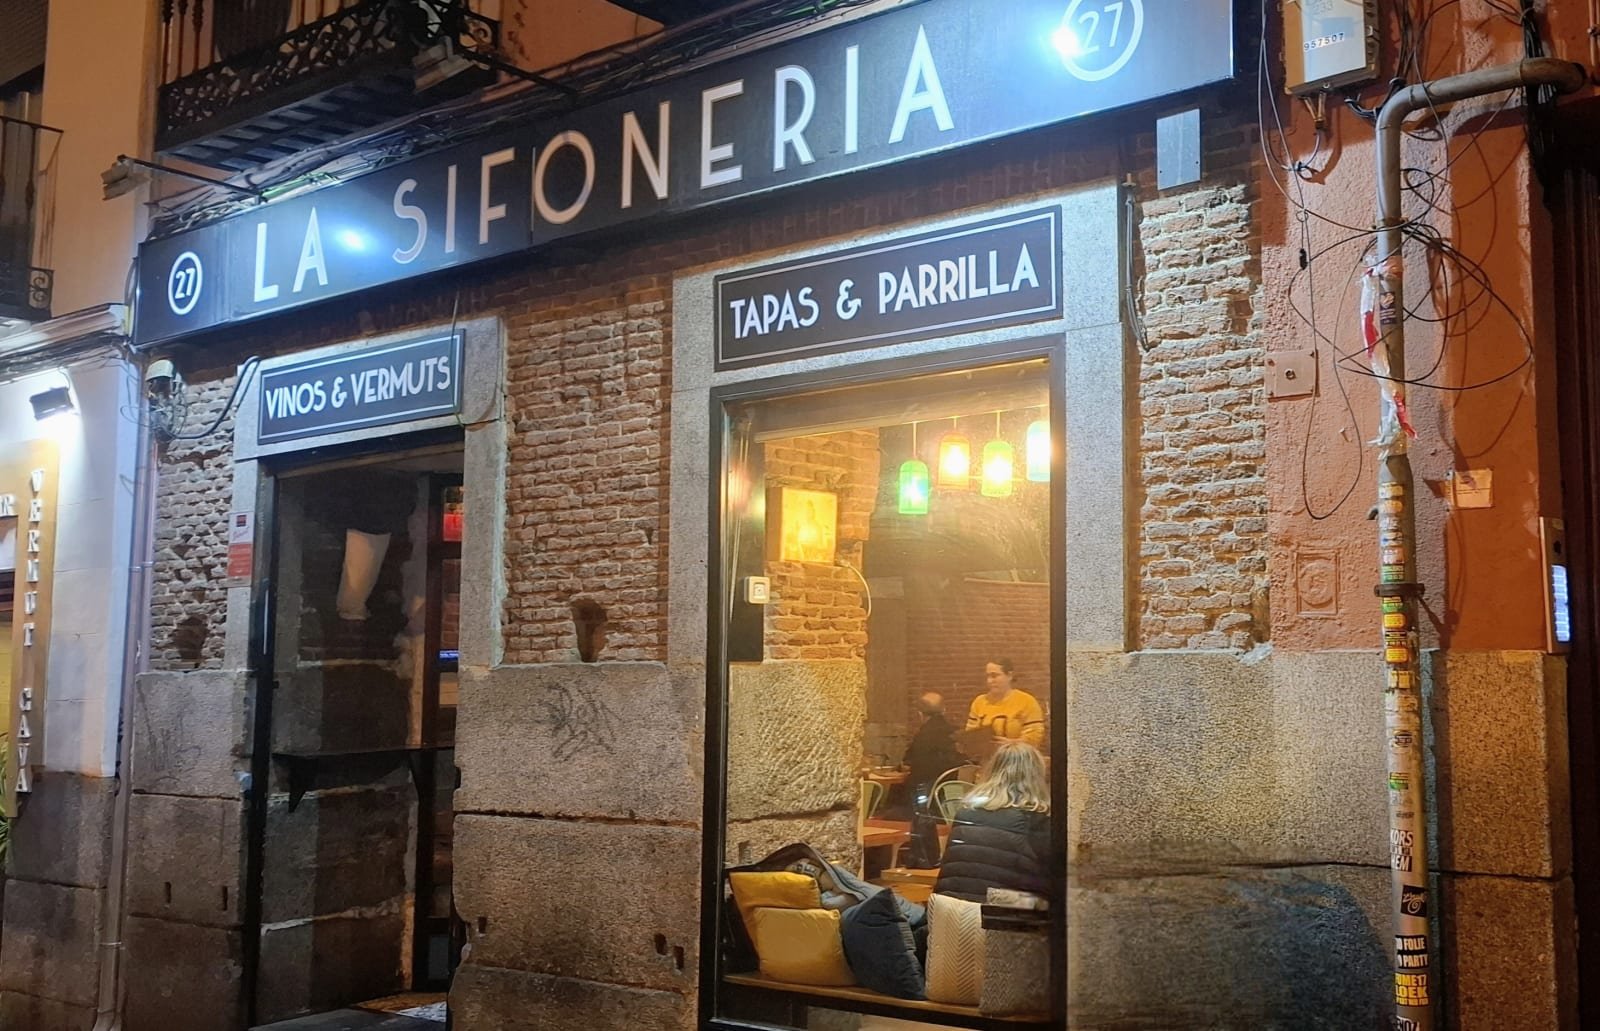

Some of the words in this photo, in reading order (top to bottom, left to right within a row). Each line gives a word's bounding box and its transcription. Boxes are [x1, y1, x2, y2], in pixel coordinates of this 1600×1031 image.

[1076, 1, 1123, 57] 27
[1303, 32, 1344, 51] 957507
[253, 206, 328, 303] LA
[391, 23, 955, 265] SIFONERIA
[174, 267, 196, 299] 27
[730, 286, 820, 340] TAPAS
[836, 278, 862, 320] &
[878, 242, 1040, 314] PARRILLA
[265, 379, 327, 421] VINOS
[331, 376, 348, 409] &
[350, 355, 451, 407] VERMUTS
[23, 468, 45, 647] VERMUT
[15, 687, 33, 793] CAVA
[1403, 937, 1426, 951] FOLIE
[1403, 954, 1428, 968] PARTY
